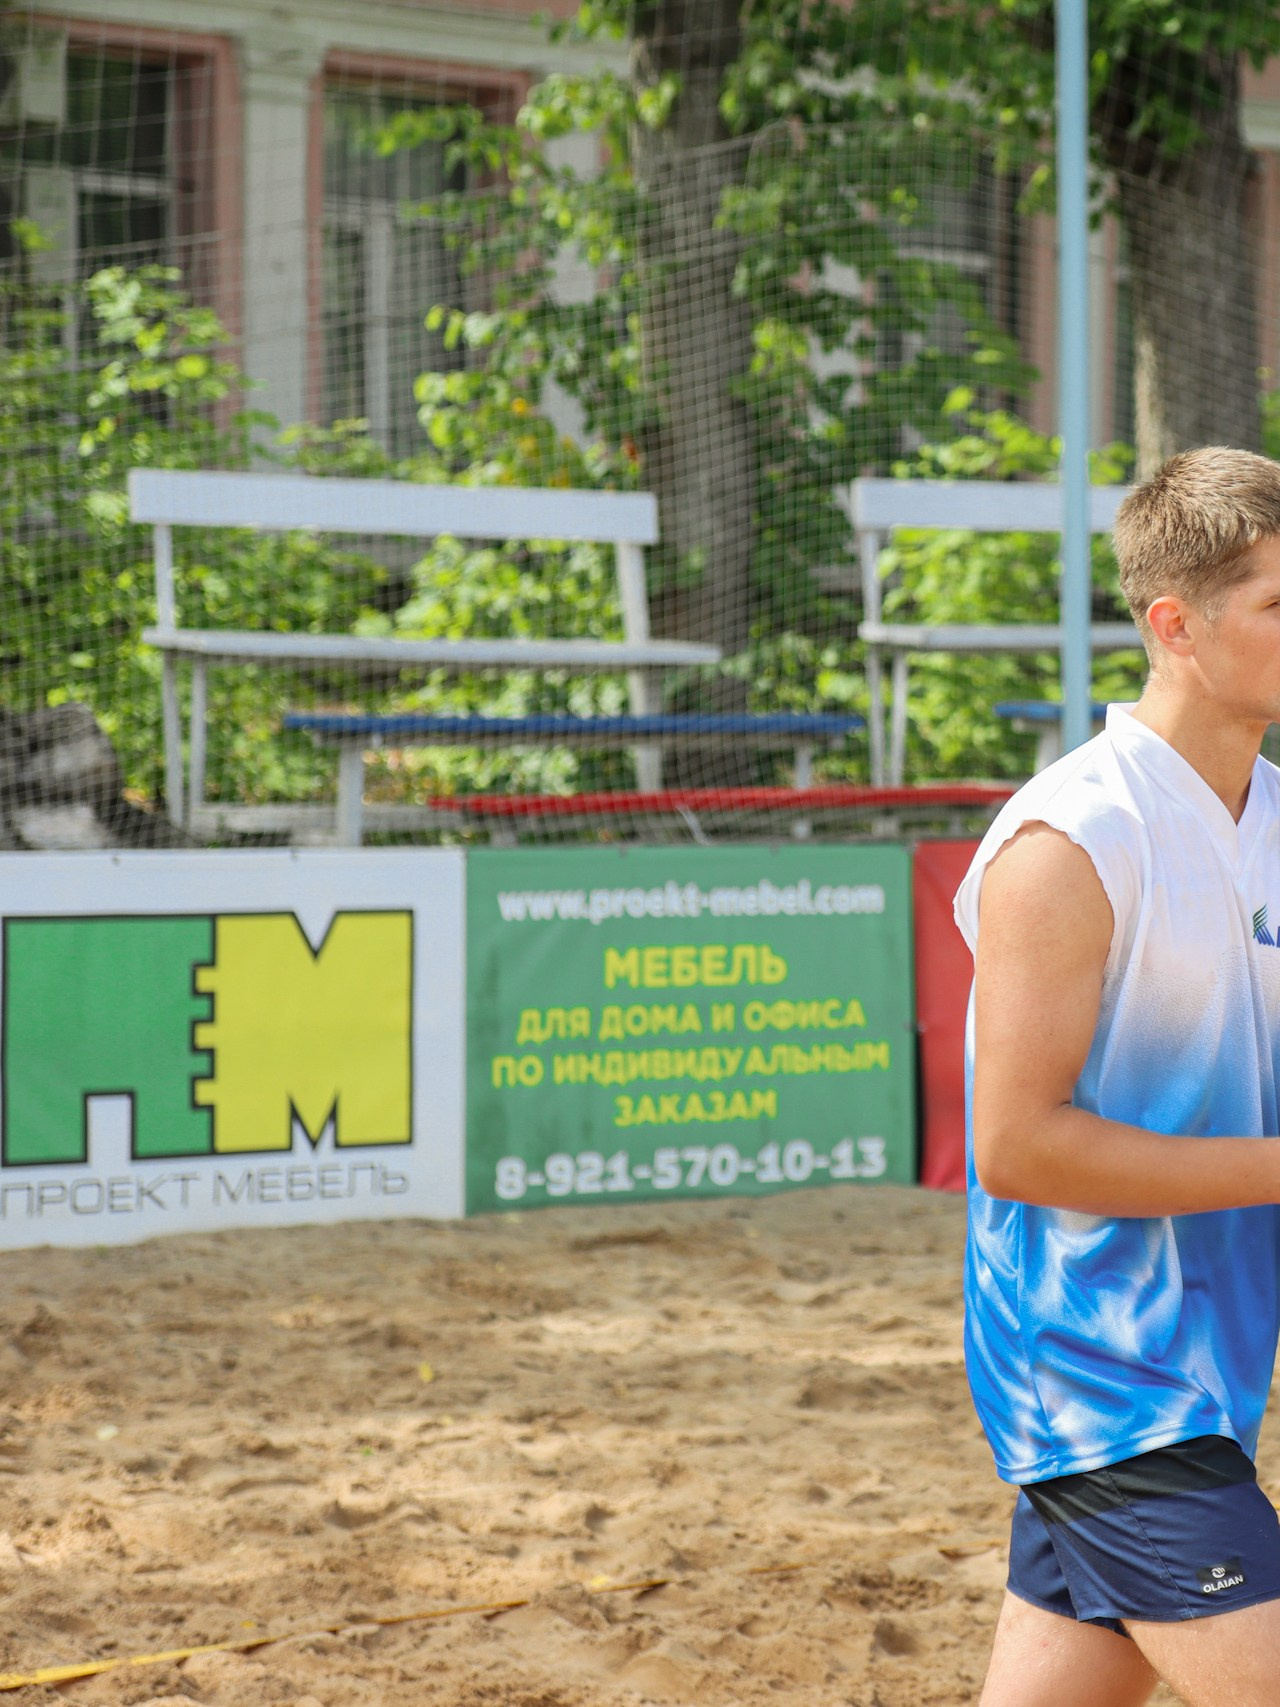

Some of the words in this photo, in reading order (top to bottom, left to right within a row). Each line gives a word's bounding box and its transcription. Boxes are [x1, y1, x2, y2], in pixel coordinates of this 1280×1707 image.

[498, 879, 885, 925] www.proekt-mebel.com
[604, 945, 787, 989] МЕБЕЛЬ
[516, 1008, 590, 1045] ДЛЯ
[599, 1005, 701, 1042] ДОМА
[712, 1003, 735, 1031] И
[743, 999, 866, 1032] ОФИСА
[492, 1055, 544, 1088] ПО
[553, 1042, 890, 1086] ИНДИВИДУАЛЬНЫМ
[614, 1089, 778, 1127] ЗАКАЗАМ
[0, 1171, 199, 1218] ПРОЕКТ
[213, 1161, 409, 1205] МЕБЕЛЬ
[495, 1137, 886, 1199] 8-921-570-10-13
[1203, 1575, 1244, 1593] OLAIAN
